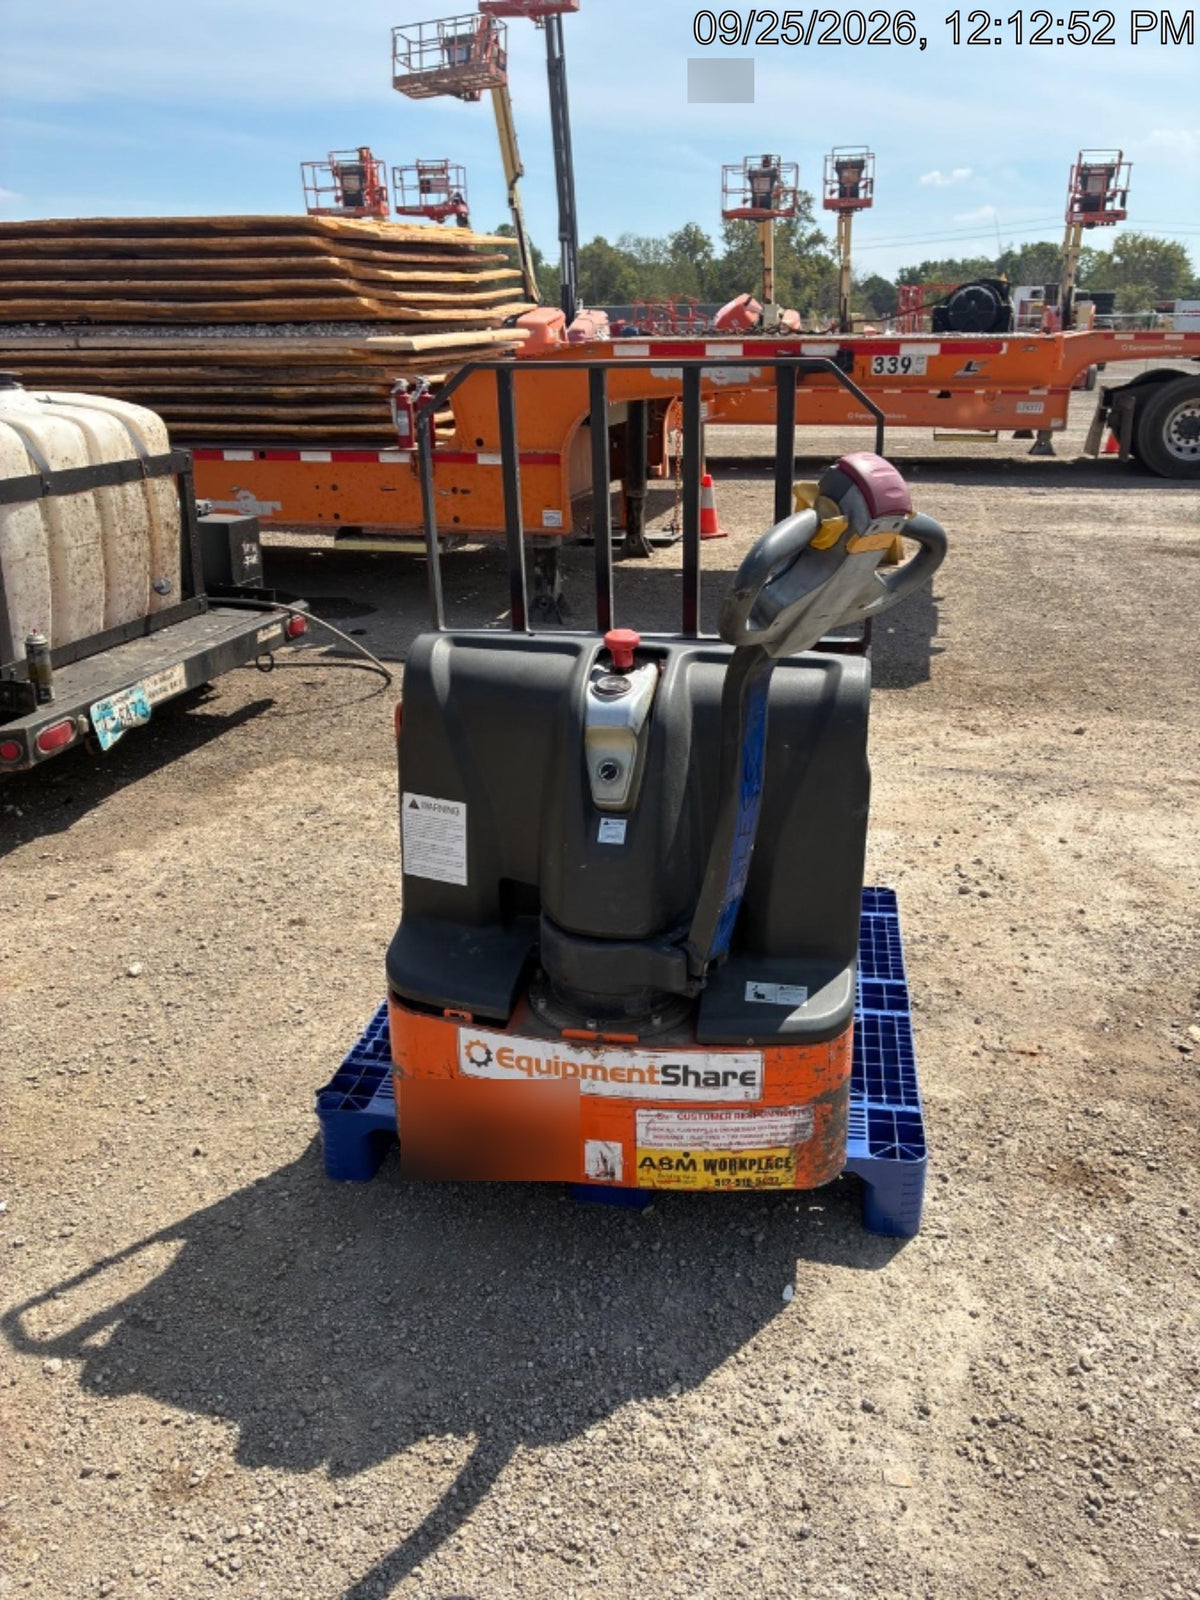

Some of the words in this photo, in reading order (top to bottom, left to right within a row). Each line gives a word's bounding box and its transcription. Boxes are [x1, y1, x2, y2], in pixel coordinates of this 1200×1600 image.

[873, 356, 912, 374] 339
[496, 1047, 756, 1087] EquipmentShare
[703, 1156, 792, 1173] WORKPLACE
